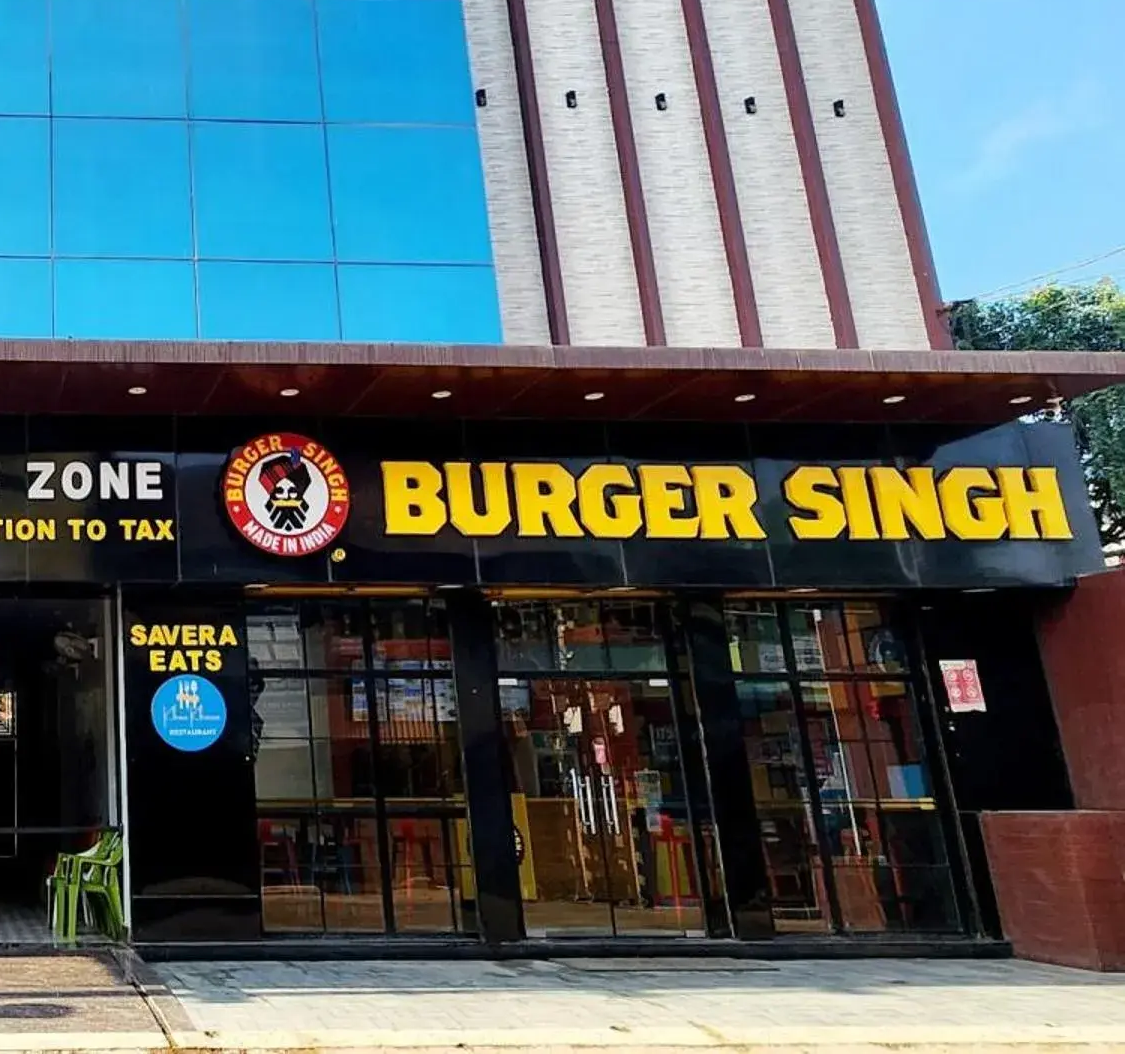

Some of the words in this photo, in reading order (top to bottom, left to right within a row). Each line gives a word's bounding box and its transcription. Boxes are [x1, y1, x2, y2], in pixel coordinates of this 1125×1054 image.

[26, 461, 164, 500] ZONE
[226, 434, 283, 502] BURGER
[303, 442, 349, 502] SINGH
[380, 460, 768, 540] BURGER
[786, 464, 1074, 541] SINGH
[67, 518, 107, 542] TO
[118, 518, 175, 542] TAX
[242, 519, 281, 552] MADE
[282, 537, 298, 553] IN
[298, 522, 337, 552] INDIA
[129, 624, 238, 647] SAVERA
[148, 649, 223, 673] EATS
